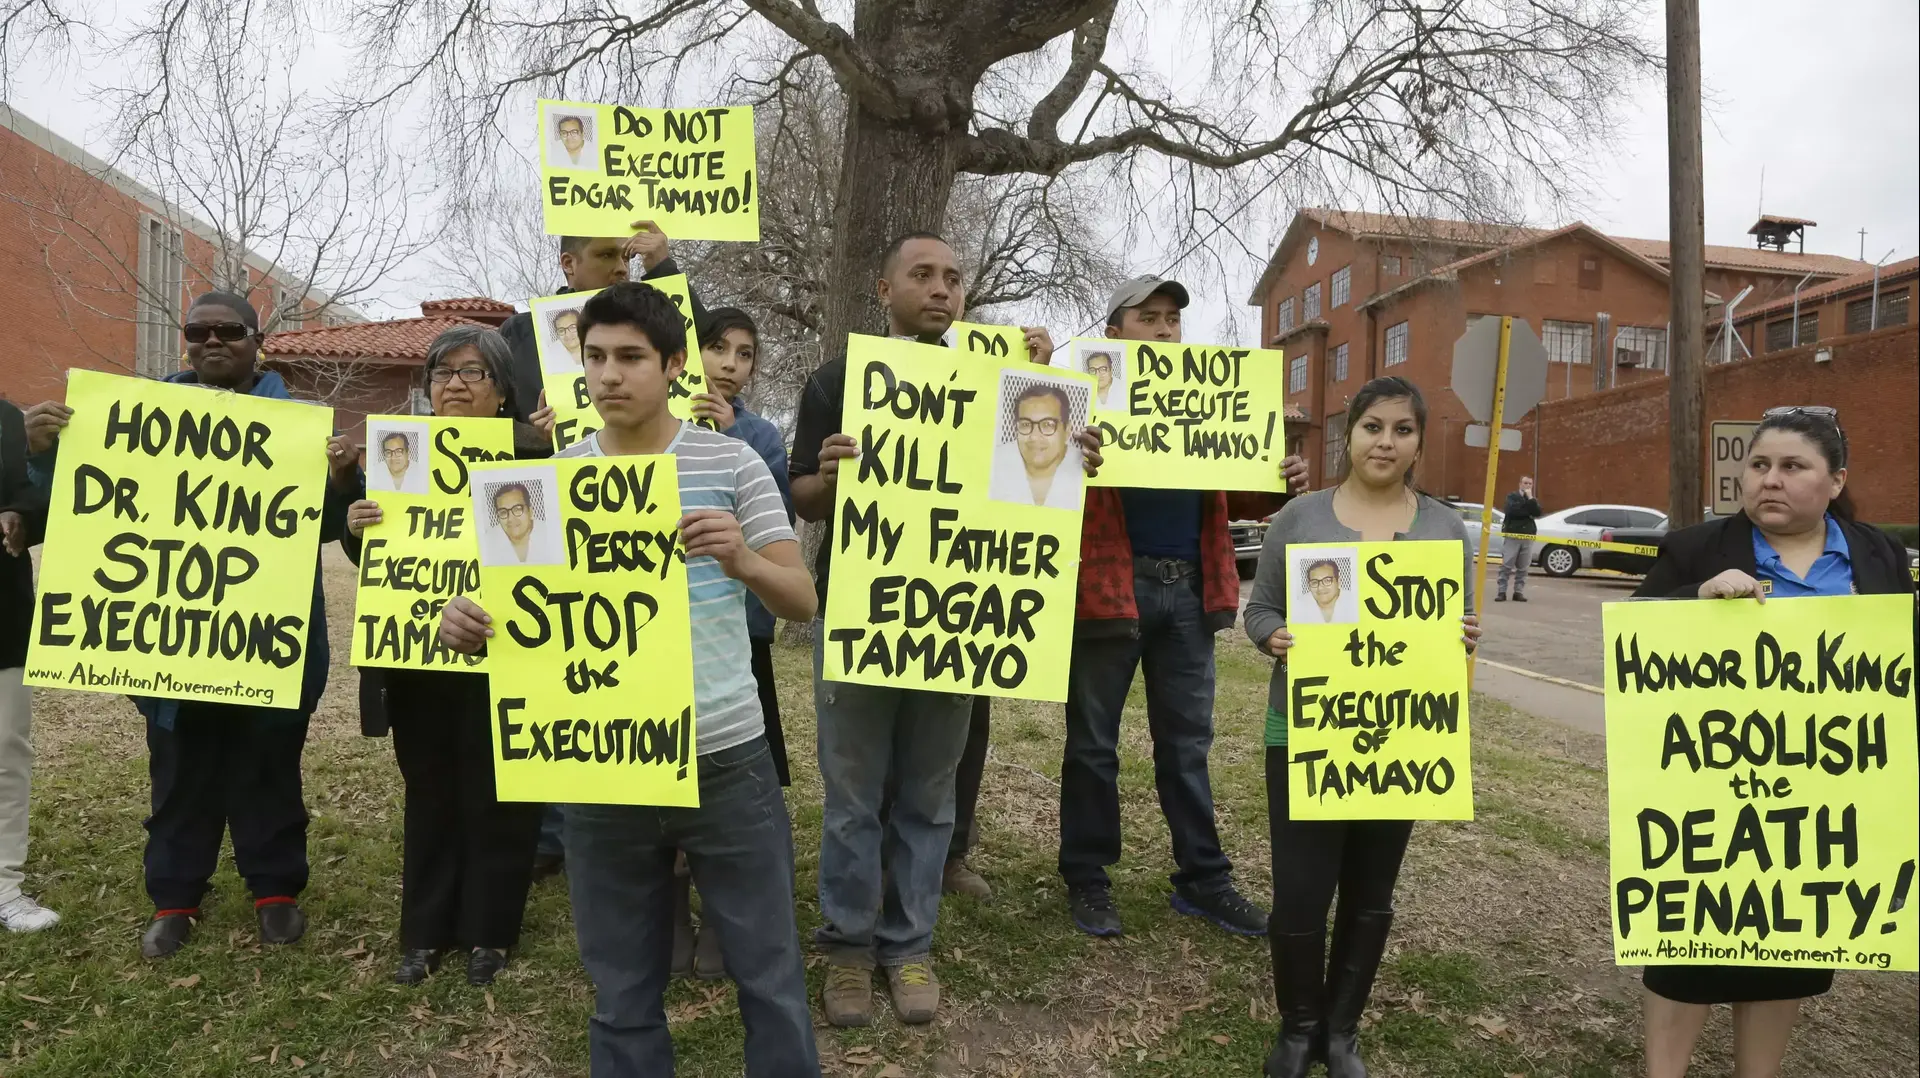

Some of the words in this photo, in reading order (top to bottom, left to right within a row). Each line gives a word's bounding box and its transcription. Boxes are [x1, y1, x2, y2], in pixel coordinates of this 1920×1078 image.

[662, 107, 731, 145] NOT
[548, 175, 636, 214] EDGAR
[637, 168, 753, 218] TAMAYO!
[603, 143, 727, 182] EXECUTE
[1181, 346, 1251, 389] NOT
[1128, 377, 1252, 424] EXECUTE
[103, 398, 276, 471] HONOR
[856, 422, 964, 496] KILL
[1092, 414, 1173, 456] DGAR
[1172, 409, 1278, 463] TAMAYO!
[1716, 436, 1744, 462] DO
[72, 461, 150, 525] DR.
[568, 459, 659, 517] GOV.
[404, 504, 466, 541] THE
[928, 505, 1063, 581] FATHER
[91, 530, 262, 607] STOP
[359, 537, 483, 600] EXECUTIO
[1362, 551, 1460, 621] STOP
[37, 590, 306, 670] EXECUTIONS
[410, 597, 449, 621] OF
[505, 574, 660, 658] STOP
[866, 573, 1046, 645] EDGAR
[357, 613, 487, 668] TAMA
[827, 626, 1030, 691] TAMAYO
[1342, 627, 1408, 668] the
[1614, 630, 1747, 695] HONOR
[562, 657, 621, 695] the
[1290, 674, 1461, 735] EXECUTION
[495, 696, 693, 783] EXECUTION!
[1351, 727, 1392, 756] OF
[1659, 707, 1889, 777] ABOLISH
[1289, 747, 1457, 806] TAMAYO
[1728, 766, 1794, 800] the
[1635, 801, 1860, 874] DEATH
[1615, 857, 1917, 940] PENALTY!
